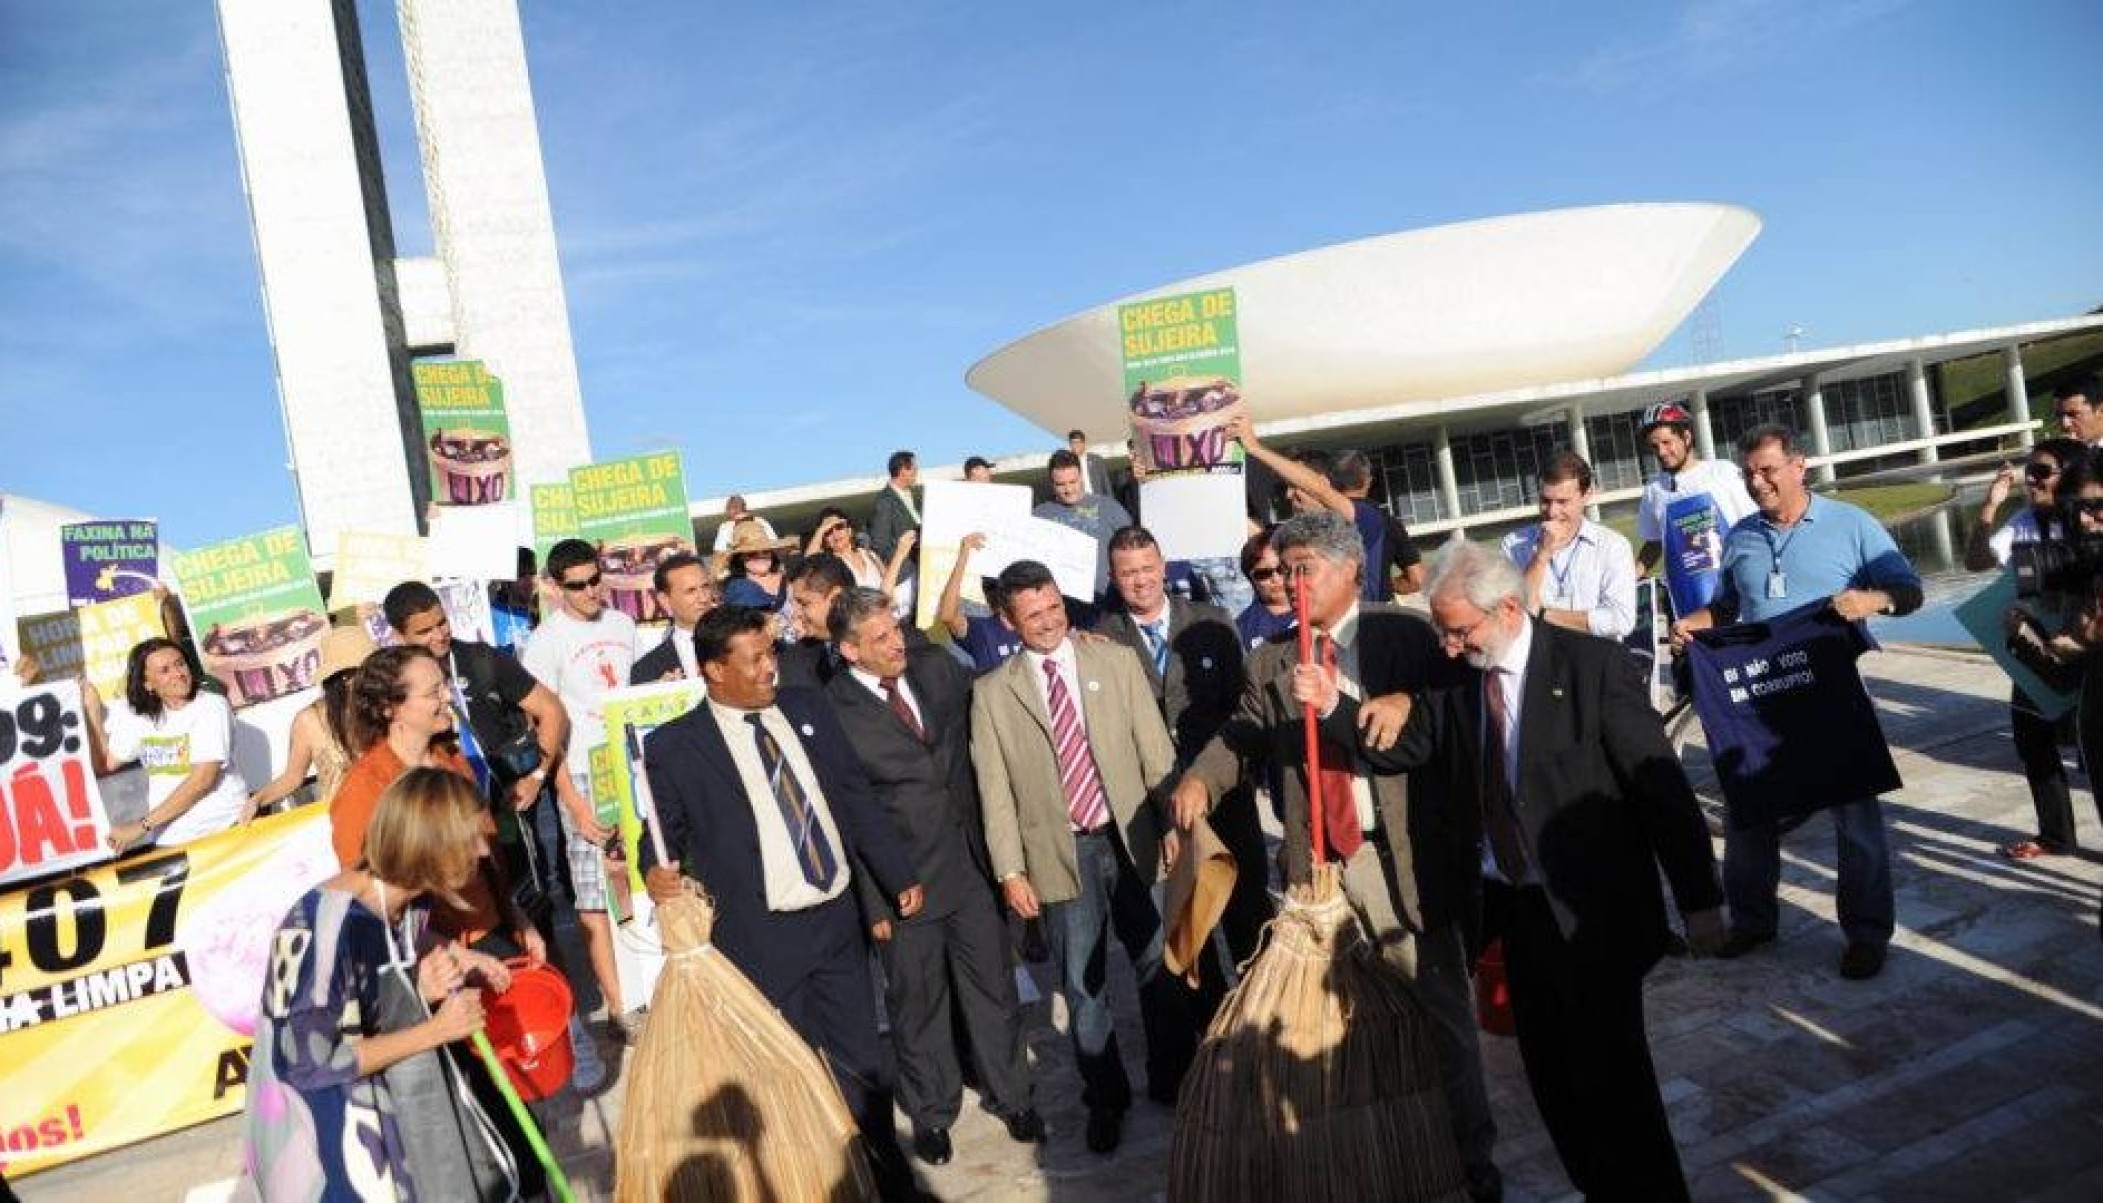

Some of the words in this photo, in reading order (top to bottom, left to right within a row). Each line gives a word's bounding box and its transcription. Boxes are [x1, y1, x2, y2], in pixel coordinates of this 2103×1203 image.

[1123, 298, 1195, 332] CHEGA
[1202, 292, 1233, 318] DE
[1125, 320, 1217, 357] SUJEIRA
[416, 363, 471, 384] CHEGA
[420, 386, 489, 407] SUJEIRA
[574, 461, 643, 492] CHEGA
[648, 455, 678, 480] DE
[576, 482, 667, 517] SUJEIRA
[63, 525, 126, 542] FAXINA
[129, 523, 155, 540] NA
[80, 542, 156, 562] POLÍTICA
[174, 540, 260, 580] CHEGA
[264, 531, 299, 556] DE
[184, 558, 291, 605] SUJEIRA
[1746, 658, 1770, 678] NÃO
[1778, 650, 1808, 669] VOTO
[51, 955, 185, 1018] LIMPA
